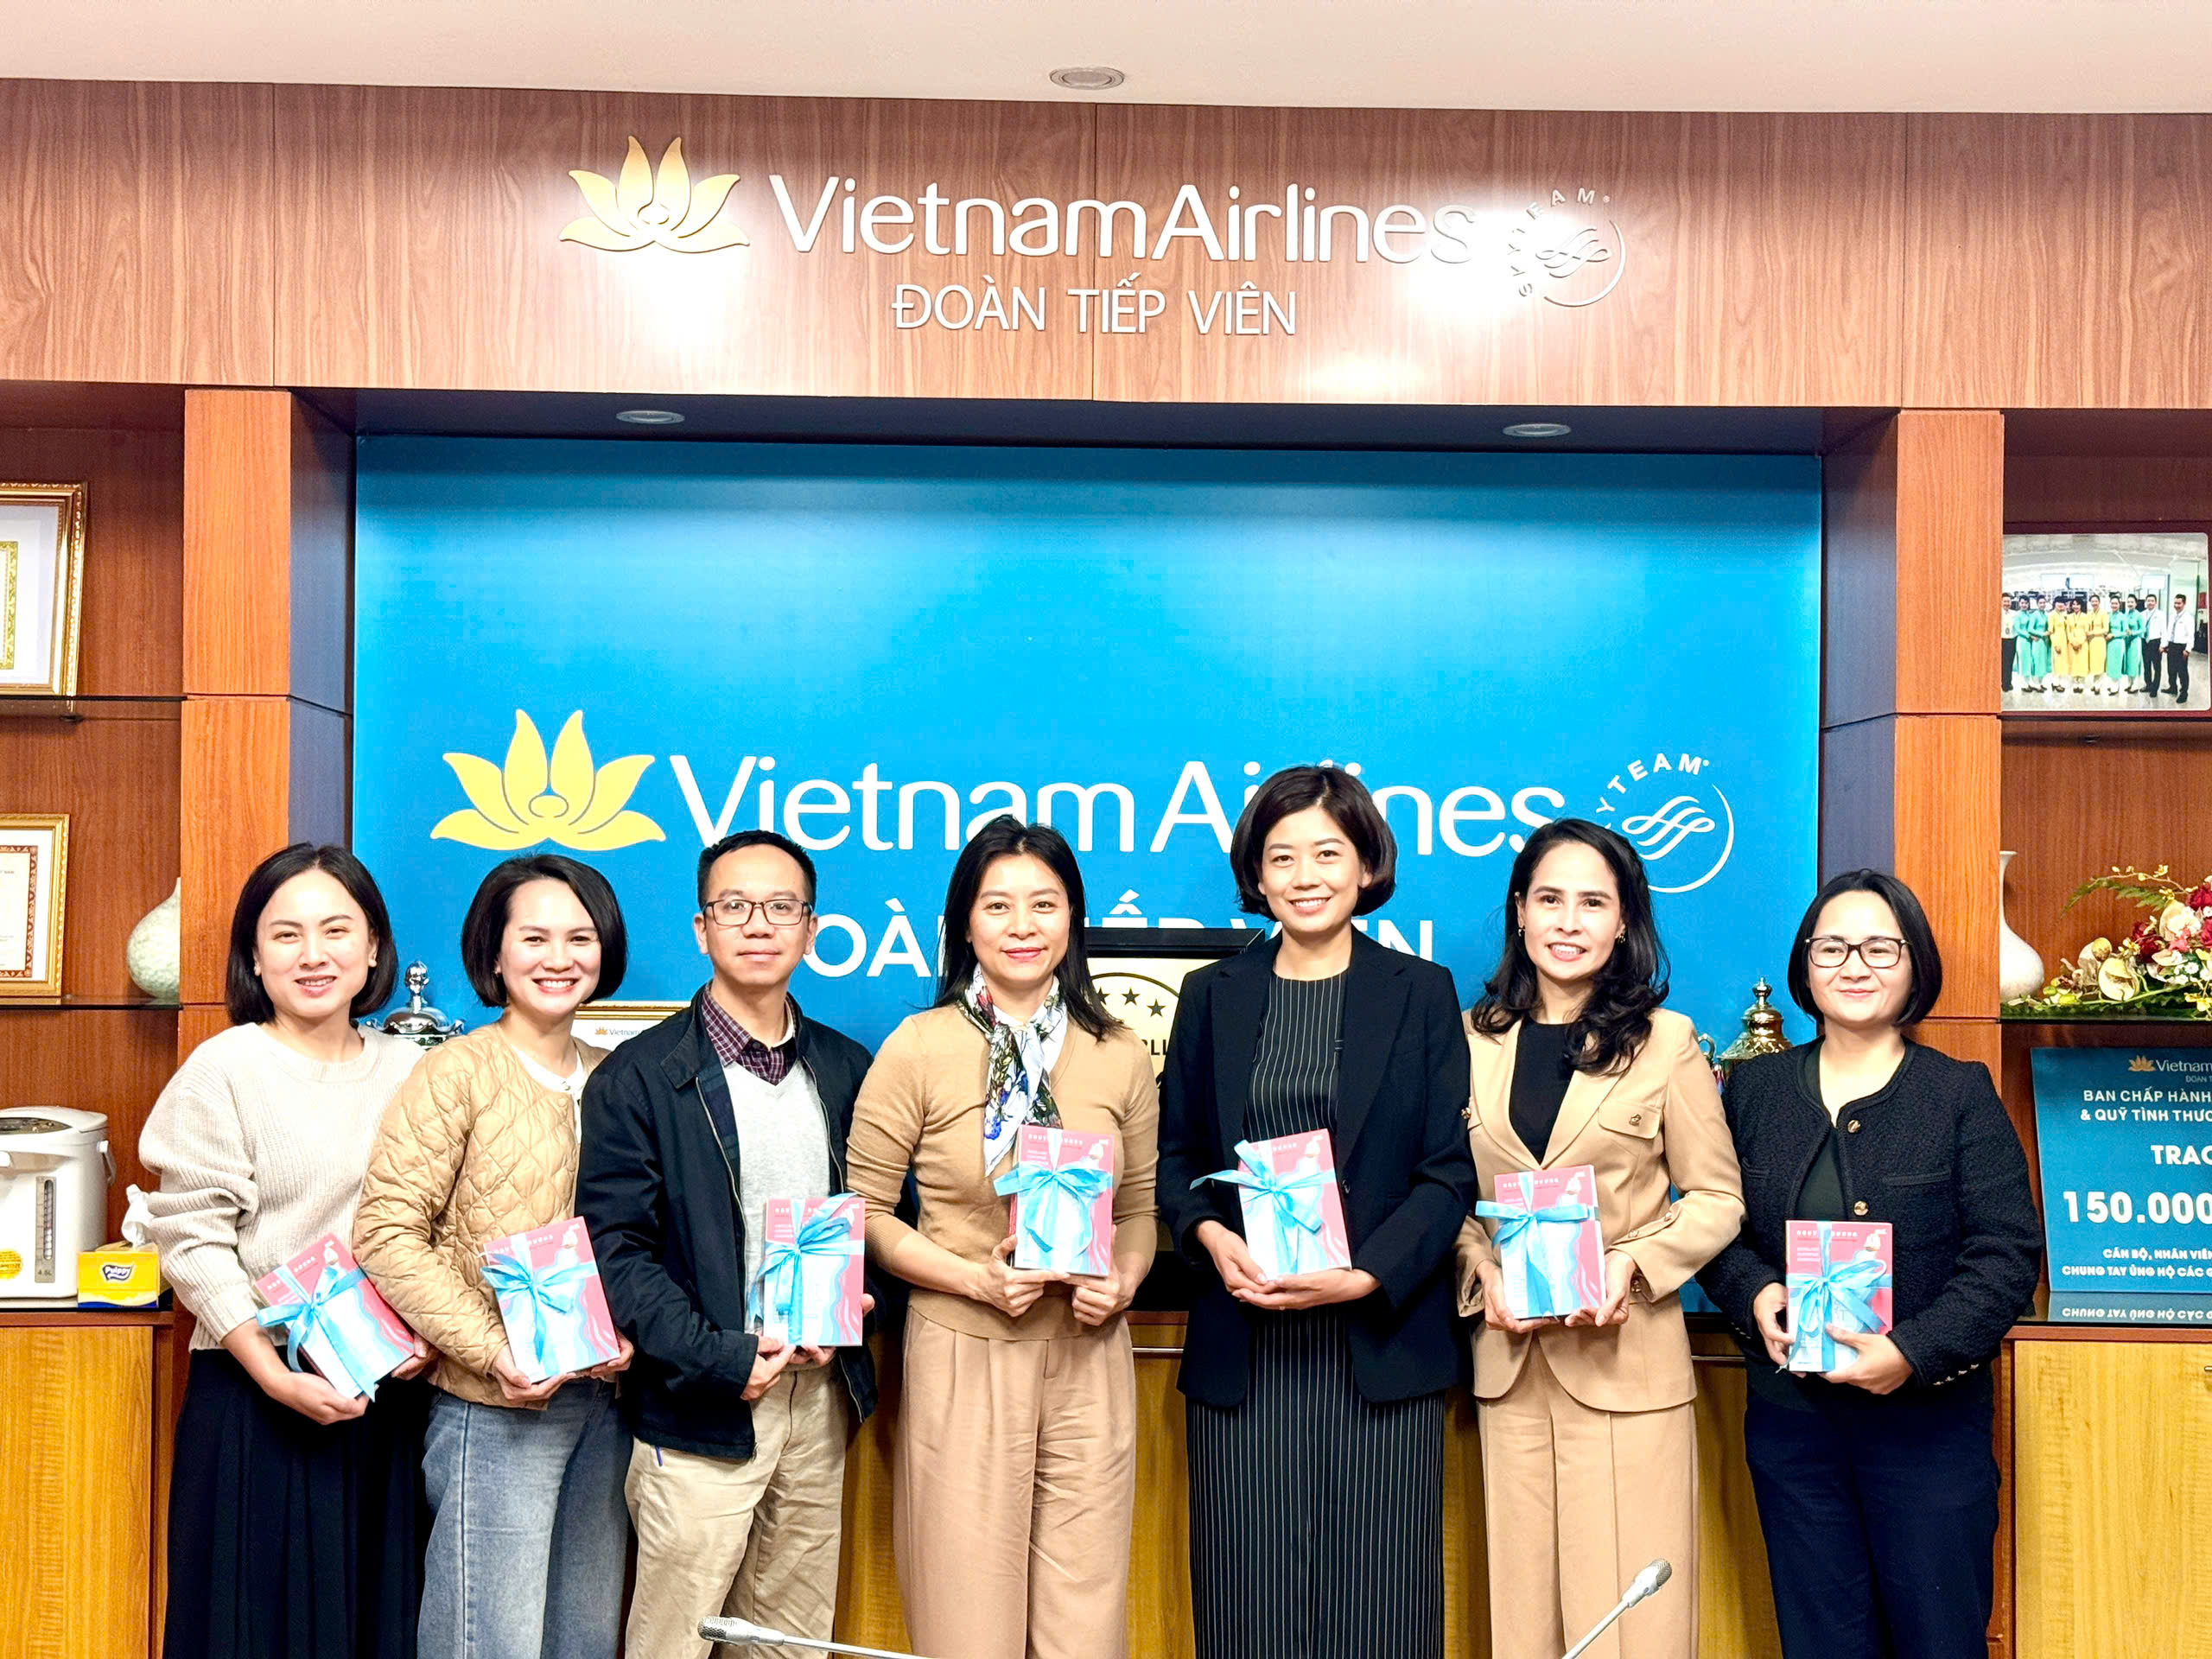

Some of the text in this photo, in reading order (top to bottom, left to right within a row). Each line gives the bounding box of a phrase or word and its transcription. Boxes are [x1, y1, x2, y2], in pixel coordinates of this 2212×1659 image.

[892, 273, 1296, 335] ĐOÀN TIẾP VIÊN
[669, 754, 1135, 852] Vietnam
[2083, 1086, 2212, 1103] BAN CHẤP HÀNH
[2080, 1109, 2091, 1121] &
[2094, 1107, 2127, 1121] QUỸ
[2131, 1107, 2169, 1122] TÌNH
[2063, 1191, 2212, 1224] 150.000
[2102, 1247, 2129, 1259] CÁN
[2154, 1248, 2188, 1260] NHÂN
[2062, 1265, 2106, 1276] CHUNG
[2107, 1266, 2127, 1276] TAY
[2177, 1265, 2204, 1278] CÁC
